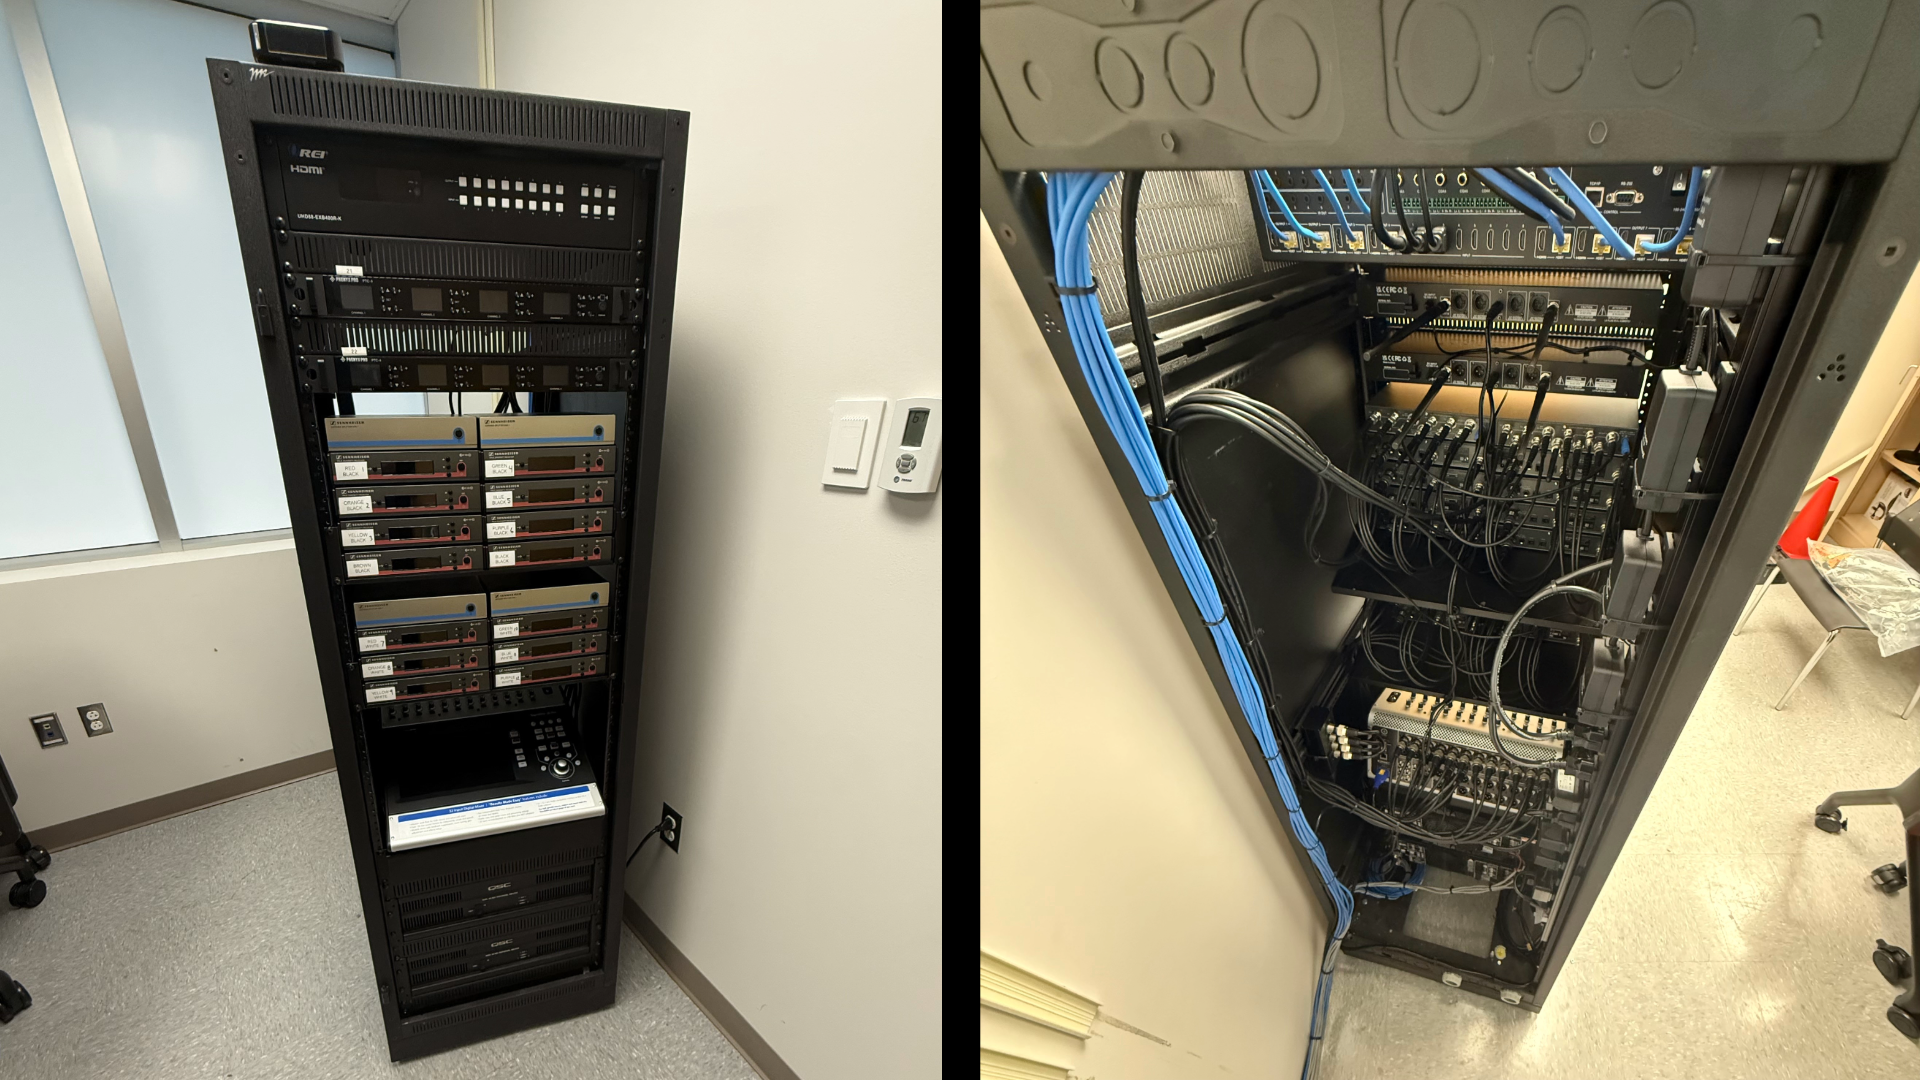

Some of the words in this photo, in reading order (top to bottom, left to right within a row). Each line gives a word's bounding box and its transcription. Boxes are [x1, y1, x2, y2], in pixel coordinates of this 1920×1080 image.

[290, 164, 324, 174] HDMI
[488, 882, 511, 891] QSC
[491, 939, 513, 948] QSC
